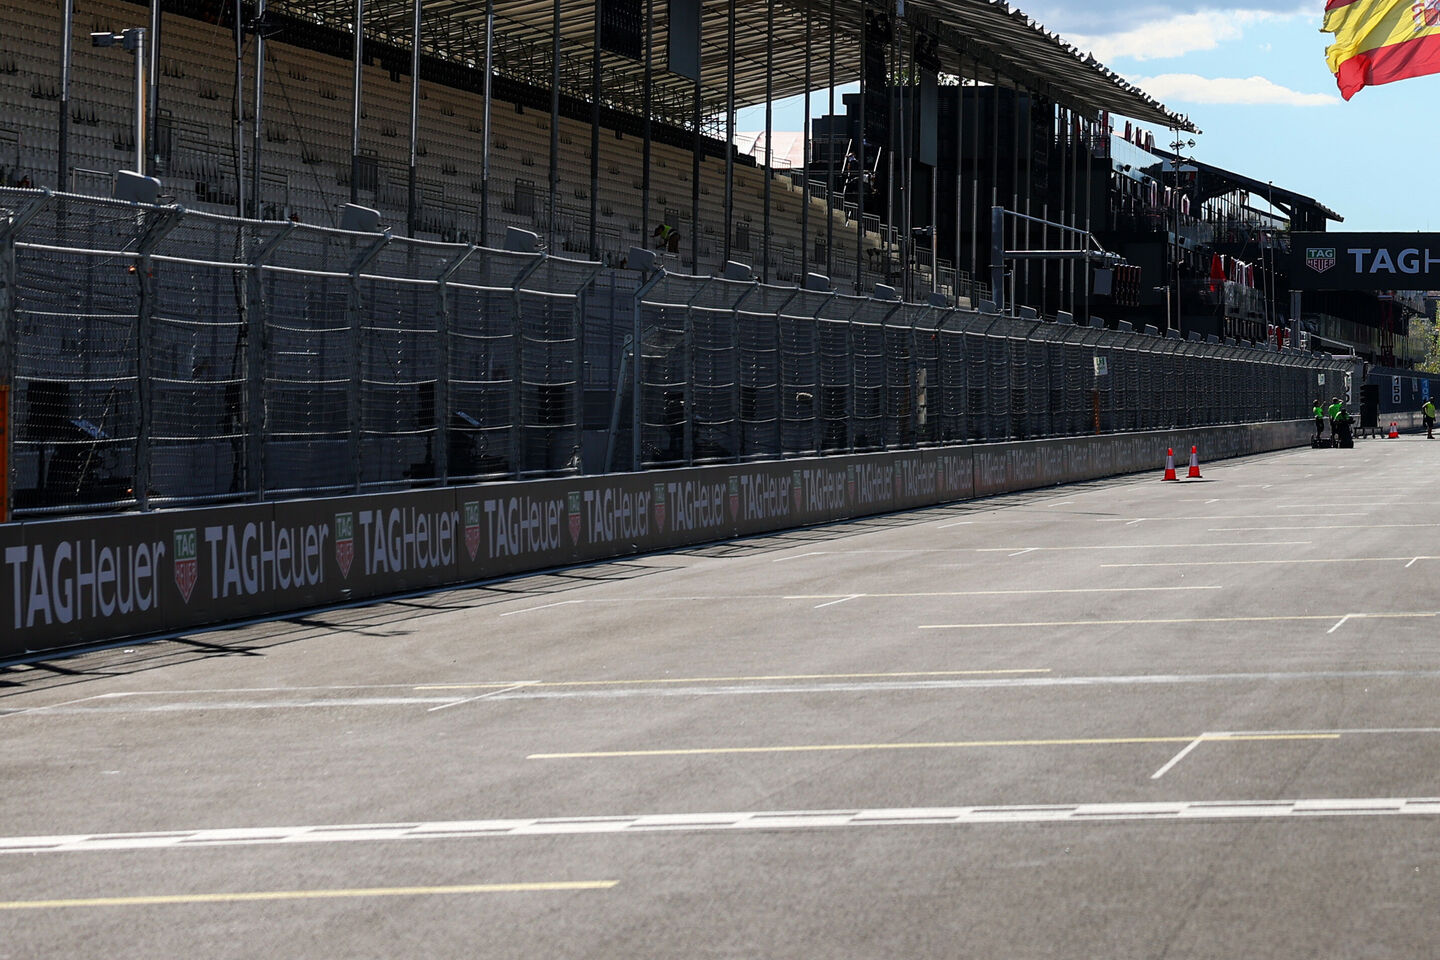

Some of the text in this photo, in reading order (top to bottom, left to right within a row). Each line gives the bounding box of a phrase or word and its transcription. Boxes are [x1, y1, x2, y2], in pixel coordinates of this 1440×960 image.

[1309, 249, 1334, 259] TAG
[1308, 260, 1334, 270] HEUER
[466, 505, 479, 525] TAG
[336, 517, 352, 539] TAG
[176, 534, 195, 556] TAG
